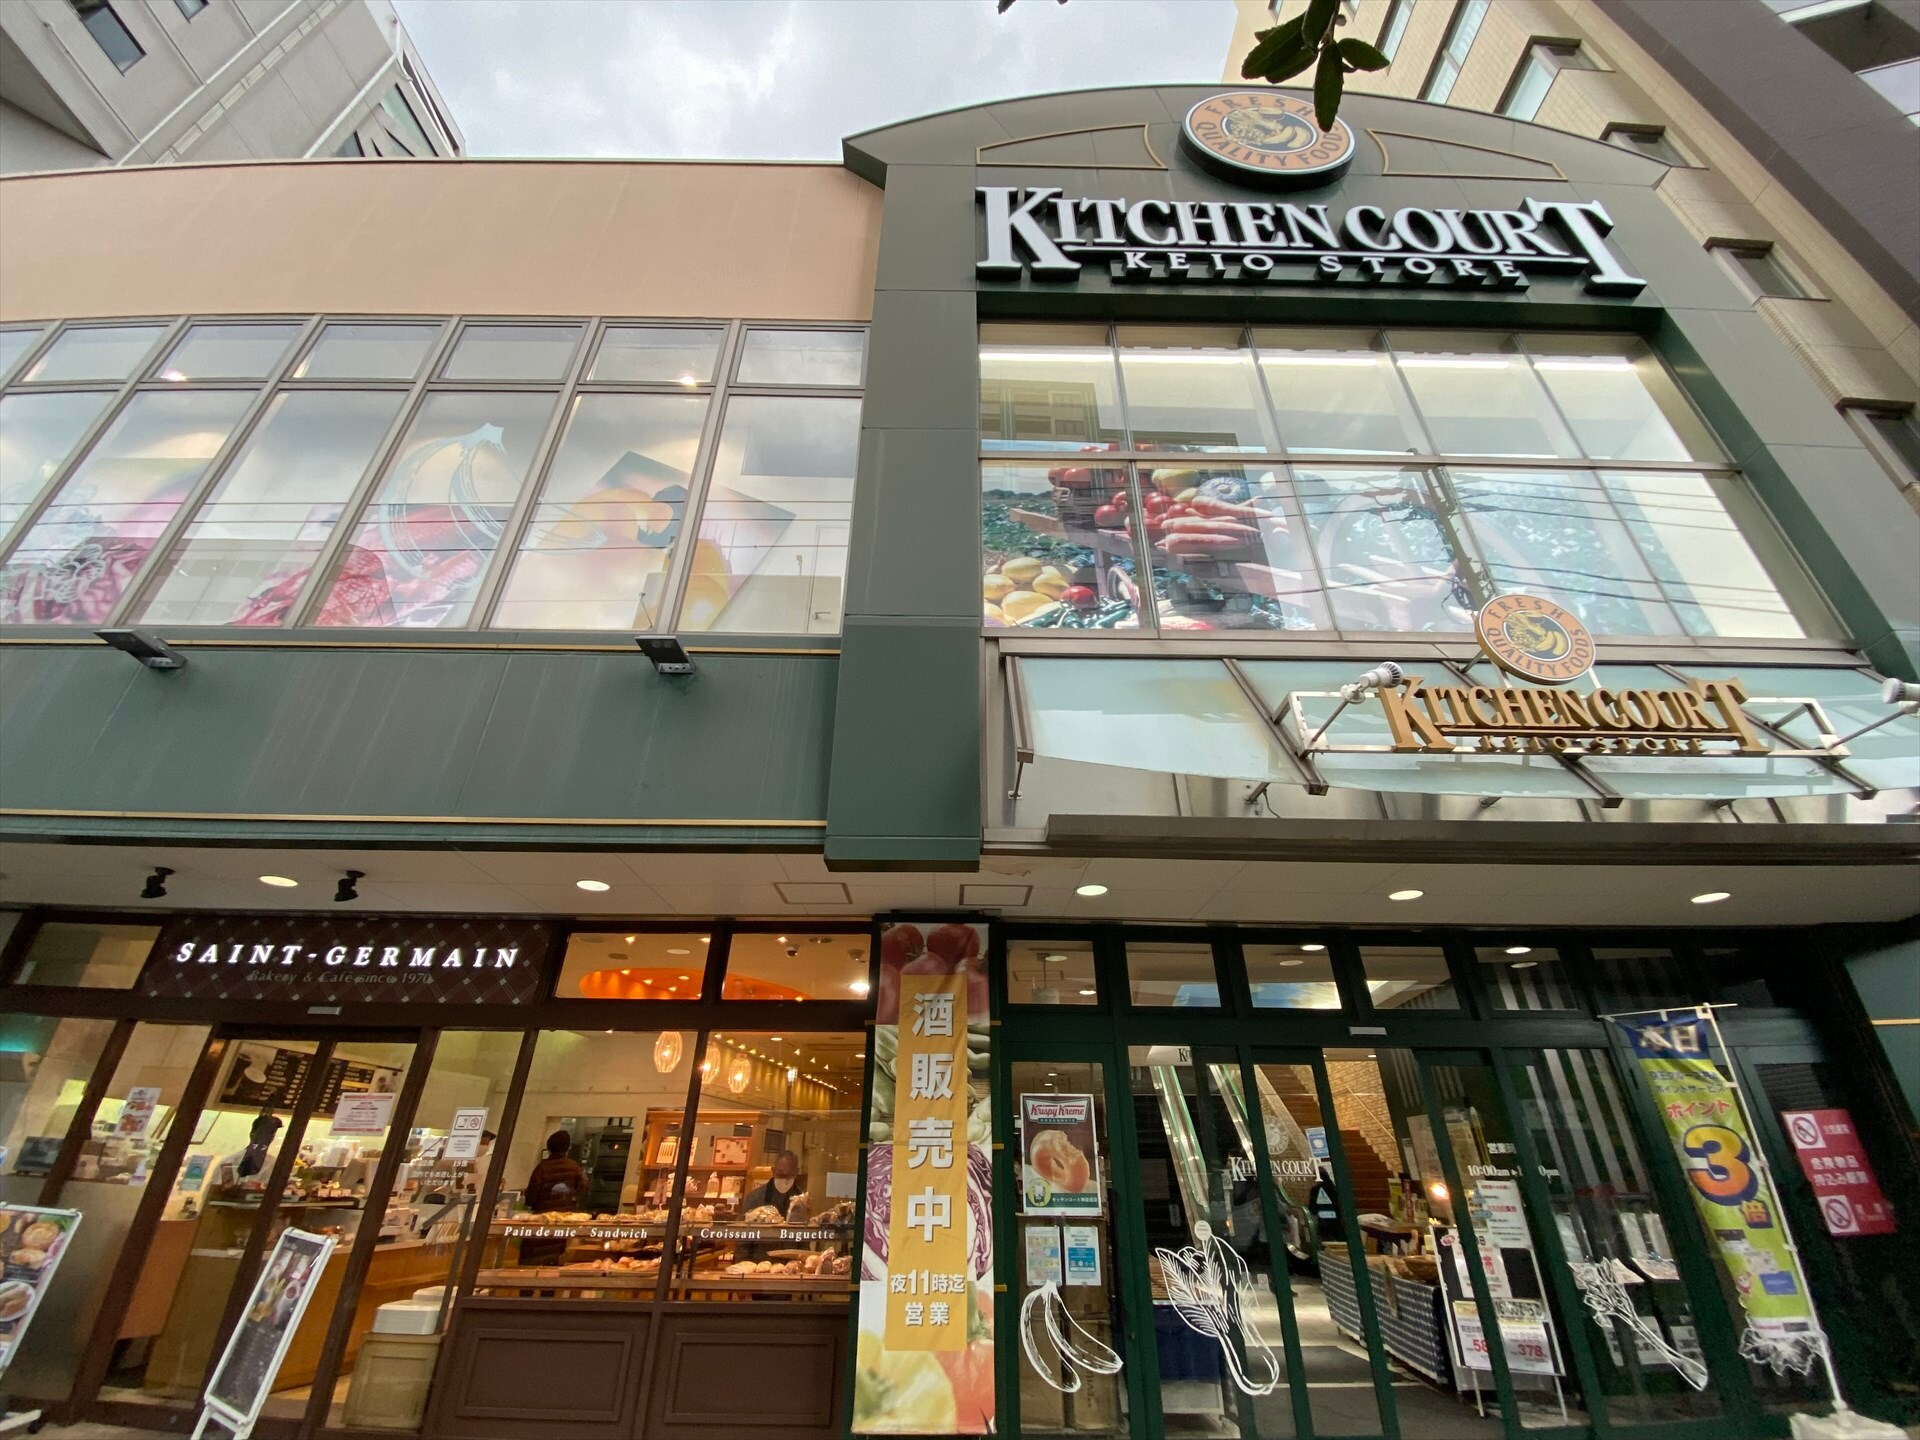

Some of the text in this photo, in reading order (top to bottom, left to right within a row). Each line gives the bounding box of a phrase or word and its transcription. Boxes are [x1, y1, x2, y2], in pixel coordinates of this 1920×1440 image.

[1204, 95, 1314, 117] FRESH
[1195, 121, 1344, 167] QUALITY FOOD
[975, 185, 1647, 290] KITCHEN COURT
[1124, 251, 1523, 281] KEIO STORE
[1488, 597, 1564, 619] FRESH
[1486, 627, 1590, 676] QUALITY FOODS
[1378, 676, 1771, 756] KITCHEN COURT
[1478, 734, 1705, 754] KEIO STORE
[176, 941, 518, 969] SAINT-GERMAIN
[248, 970, 298, 985] Bakery
[302, 971, 313, 984] &
[400, 972, 432, 985] 1970
[906, 991, 955, 1244] 酒販売中
[1030, 1104, 1085, 1118] Krispy Kreme
[1667, 1098, 1731, 1119] ポイント
[1683, 1123, 1759, 1206] 3
[1741, 1199, 1773, 1228] 倍
[503, 1225, 532, 1238] Pain
[535, 1226, 550, 1238] de
[589, 1227, 649, 1240] Sandwich
[699, 1228, 836, 1242] Croissant Baguette
[890, 1268, 966, 1296] 夜11時迄
[905, 1302, 950, 1327] 営業
[1517, 1344, 1544, 1358] 378
